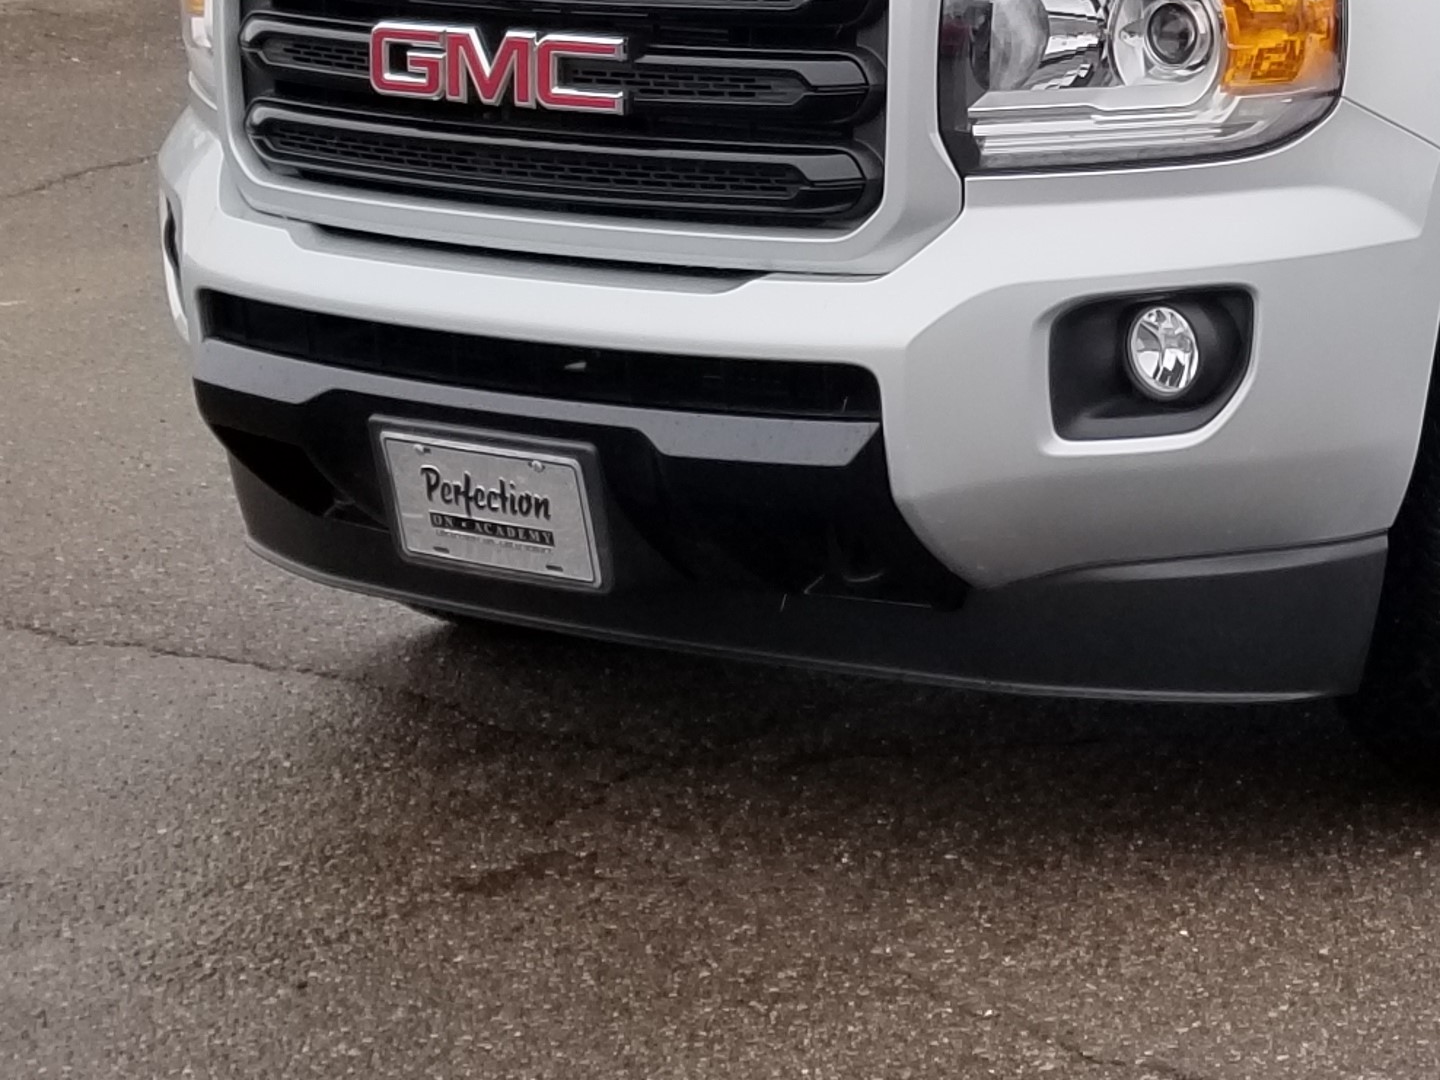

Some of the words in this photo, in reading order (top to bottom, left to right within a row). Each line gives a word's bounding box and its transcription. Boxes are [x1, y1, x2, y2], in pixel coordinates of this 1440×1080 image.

[369, 20, 628, 116] GMC
[420, 464, 552, 520] Perfection
[433, 513, 454, 528] ON
[473, 522, 552, 546] ACADEMY
